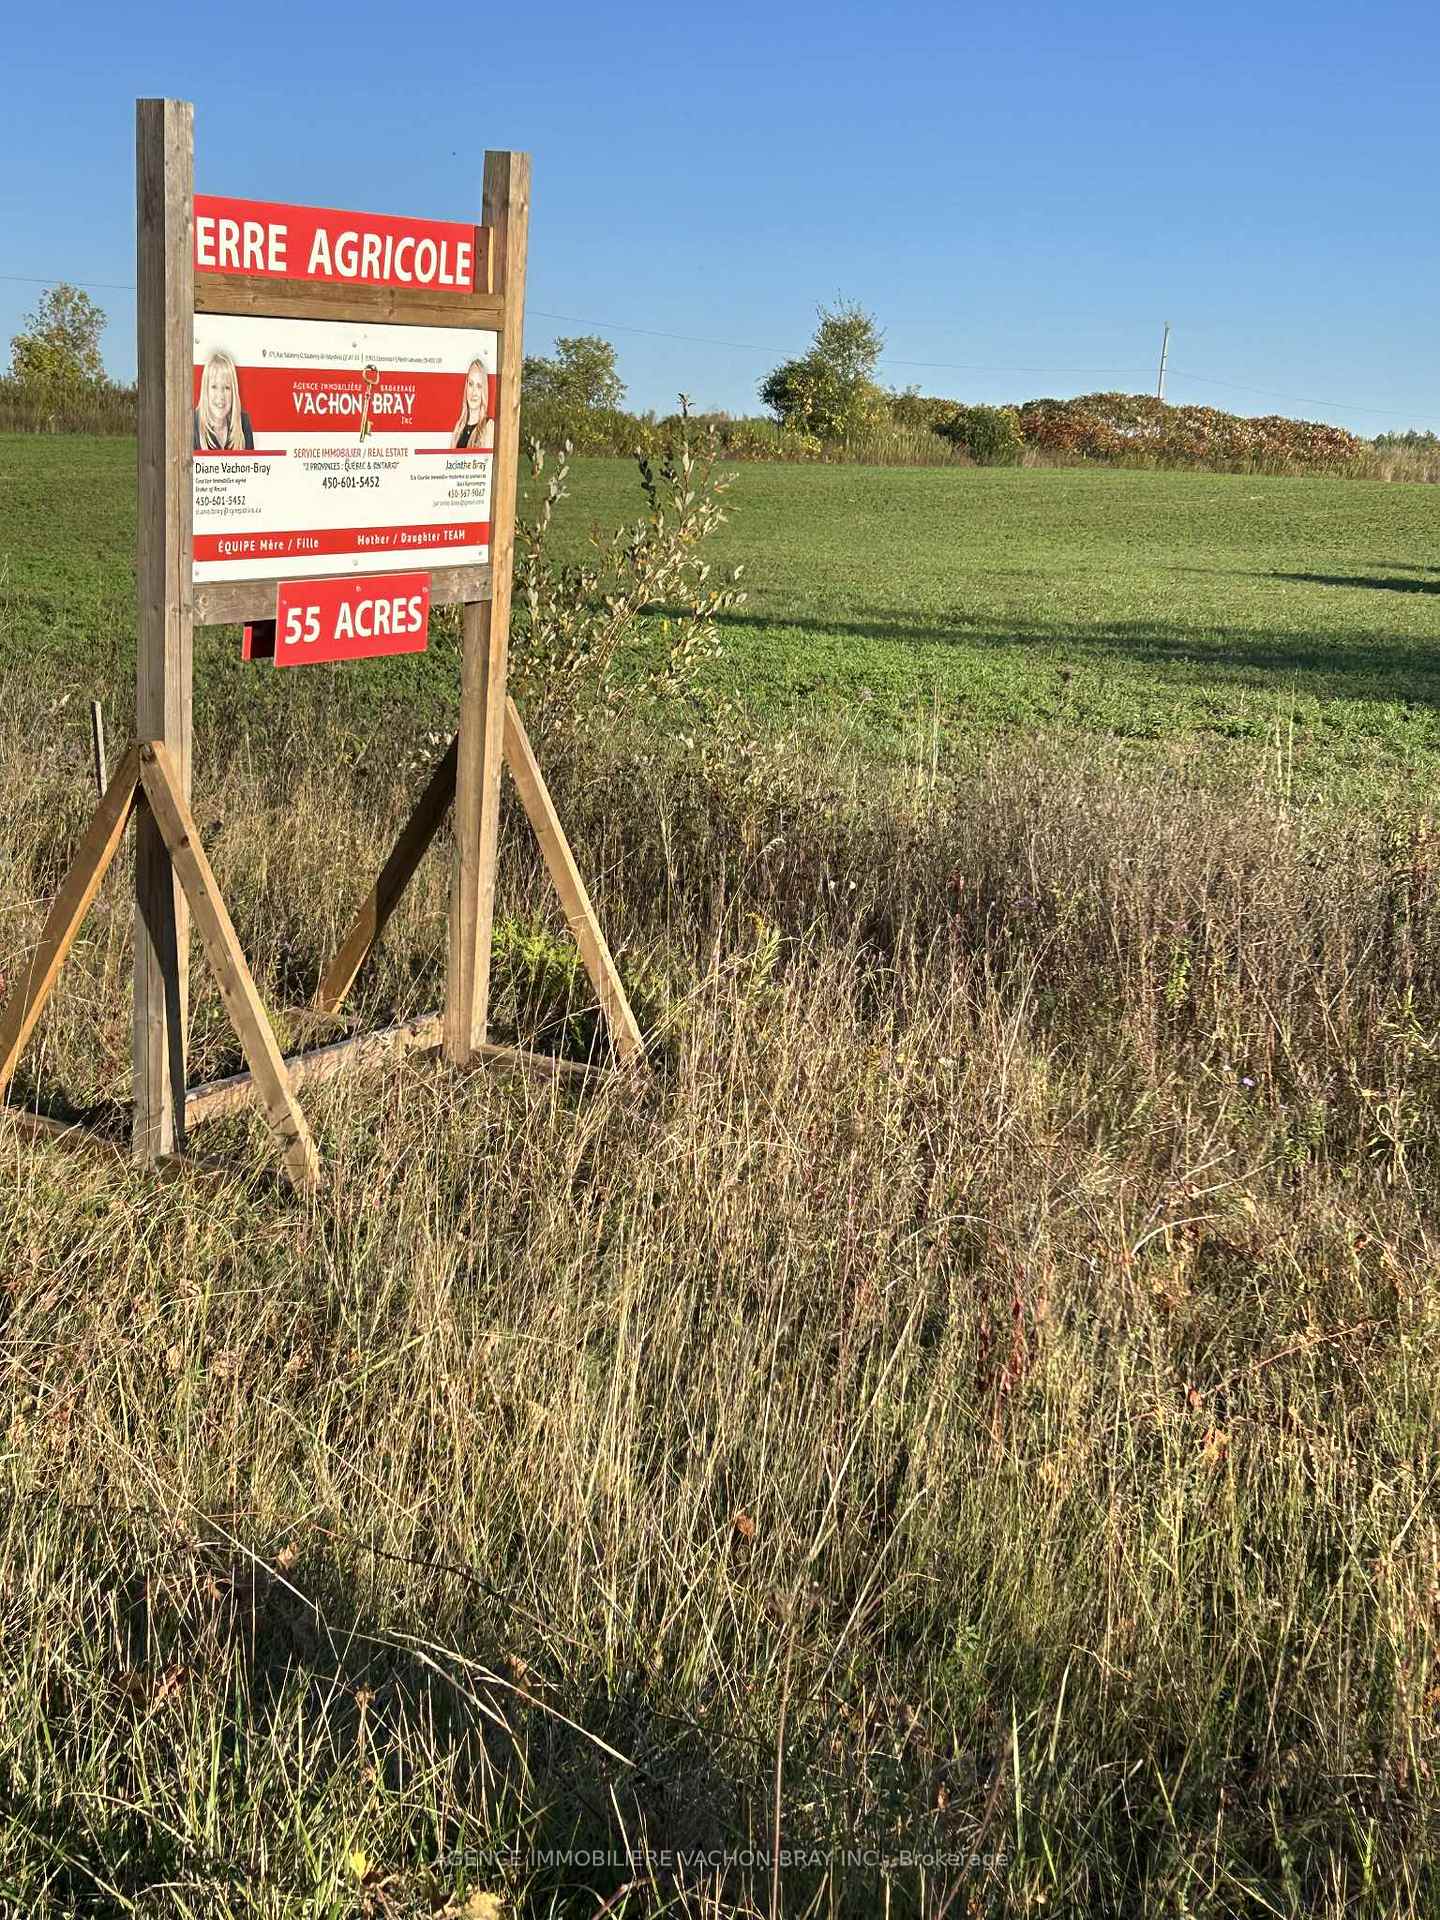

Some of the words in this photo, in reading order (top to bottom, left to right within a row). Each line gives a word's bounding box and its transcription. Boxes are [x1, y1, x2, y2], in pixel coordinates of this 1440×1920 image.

[196, 216, 288, 272] ERRE
[307, 228, 471, 285] AGRICOLE
[293, 392, 363, 414] VACHON
[372, 393, 416, 414] BRAY
[293, 448, 320, 458] SERVICE
[322, 448, 361, 458] IMMOBILIER
[368, 448, 384, 458] REAL
[385, 448, 409, 457] ESTATE
[195, 463, 219, 473] Diane
[221, 462, 271, 475] Vachon-Bray
[322, 476, 380, 489] 450-601-5452
[195, 495, 246, 506] 450-601-5452
[217, 539, 256, 555] ÉQUIPE
[260, 539, 285, 552] Mère
[296, 536, 319, 549] Fille
[357, 534, 389, 546] Mother
[400, 531, 440, 545] Daughter
[443, 529, 465, 541] TEAM
[284, 605, 321, 645] 55
[333, 595, 423, 640] ACRES
